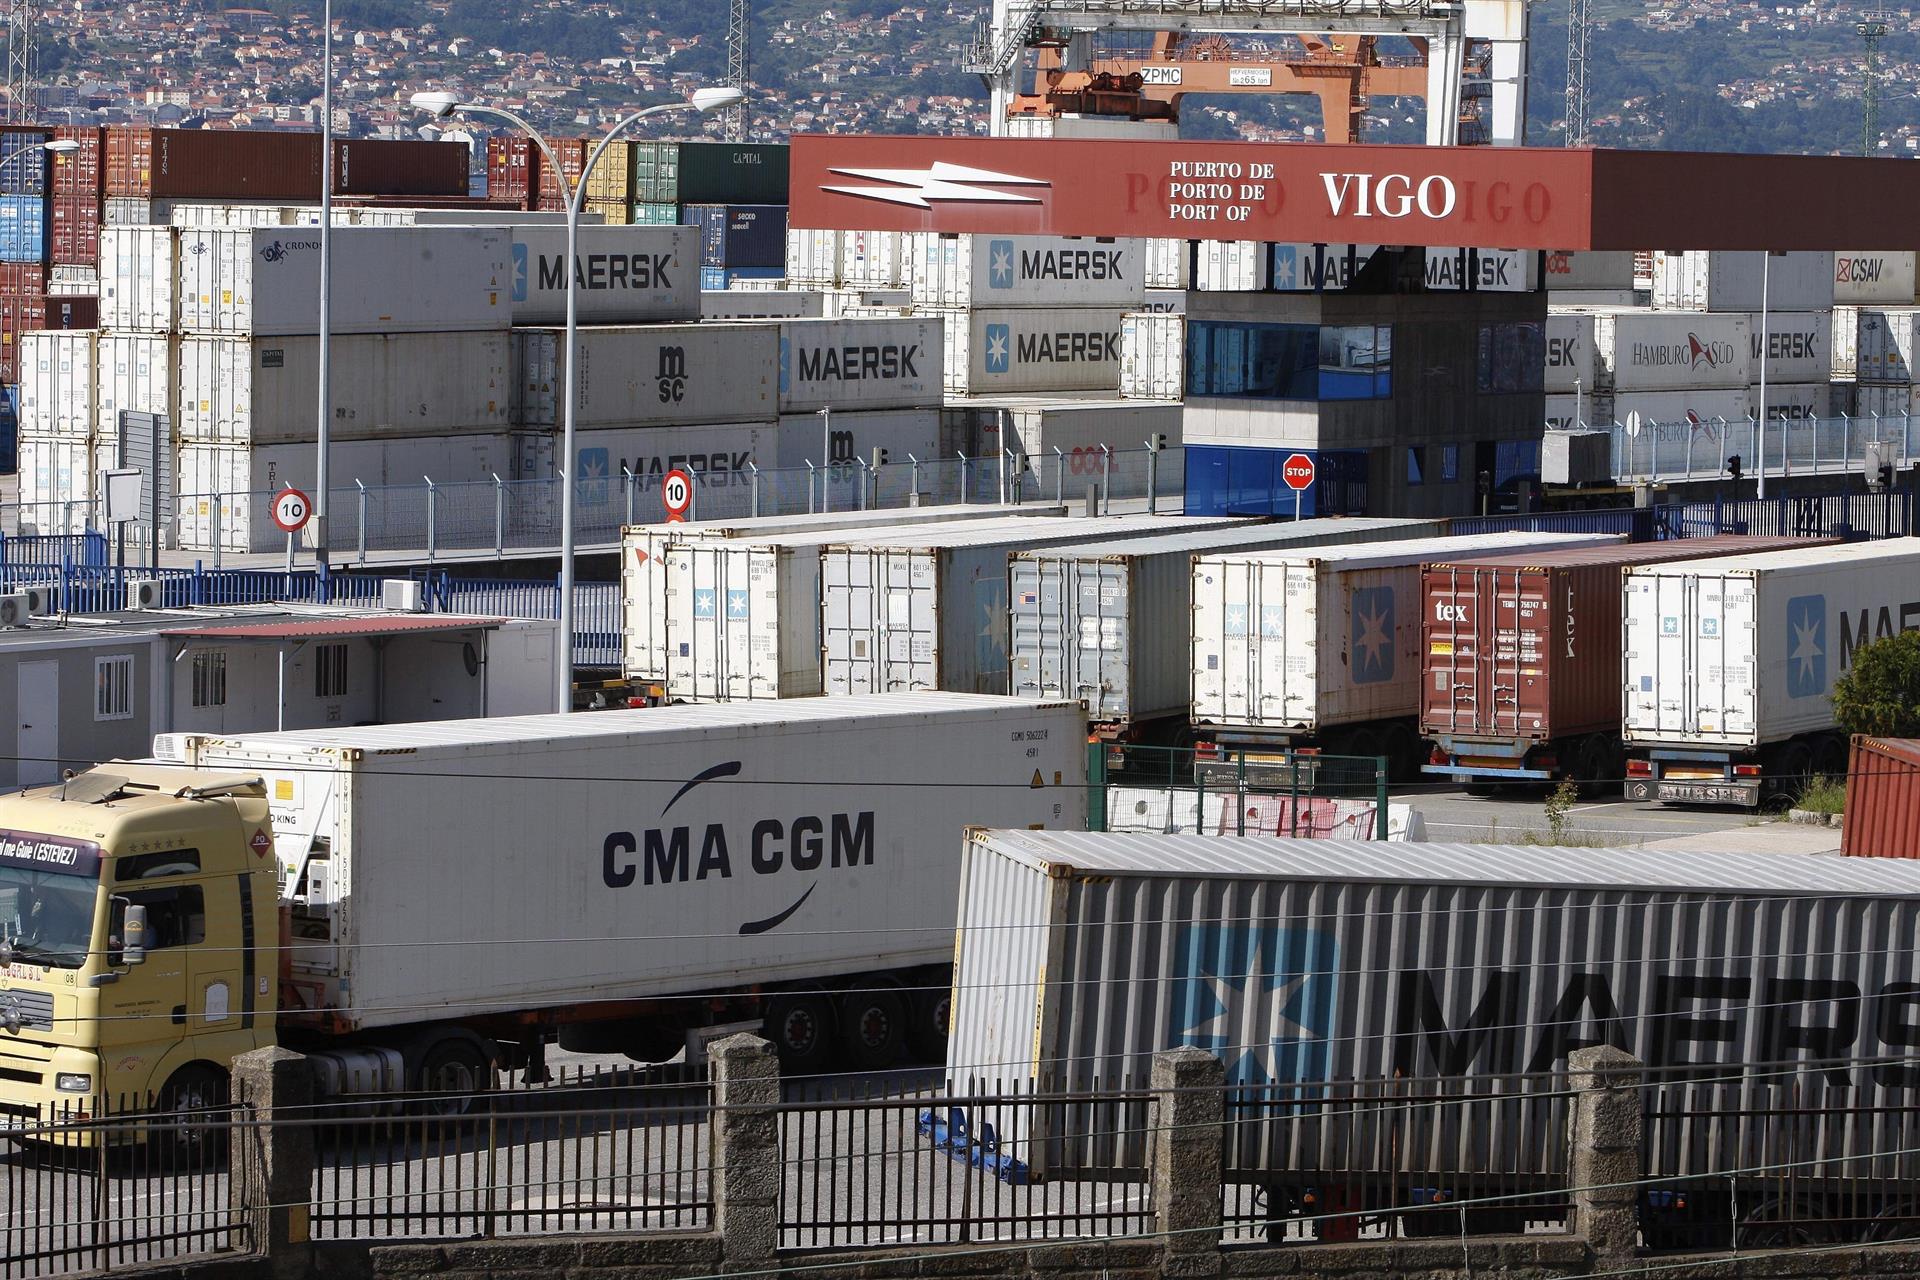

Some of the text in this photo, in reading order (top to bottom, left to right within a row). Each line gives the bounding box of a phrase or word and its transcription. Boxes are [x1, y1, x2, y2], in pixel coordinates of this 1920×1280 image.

[1142, 68, 1180, 83] ZPMC
[733, 152, 762, 164] CAPITAL
[1170, 161, 1274, 180] PUERTO DE
[1169, 182, 1265, 201] PORTO DE
[1319, 172, 1457, 219] VIGO
[1169, 204, 1251, 222] PORT OF
[539, 253, 673, 291] MAERSK
[1020, 249, 1124, 281] MAERSK
[1851, 258, 1884, 282] CSAV
[1017, 331, 1119, 365] MAERSK
[1632, 340, 1735, 366] HAMBURG SÜD
[798, 344, 919, 382] MAERSK
[1286, 467, 1311, 477] STOP
[667, 483, 684, 502] 10
[283, 503, 302, 517] 10
[277, 815, 297, 825] KING
[602, 810, 875, 889] CMA CGM
[65, 973, 75, 984] 08
